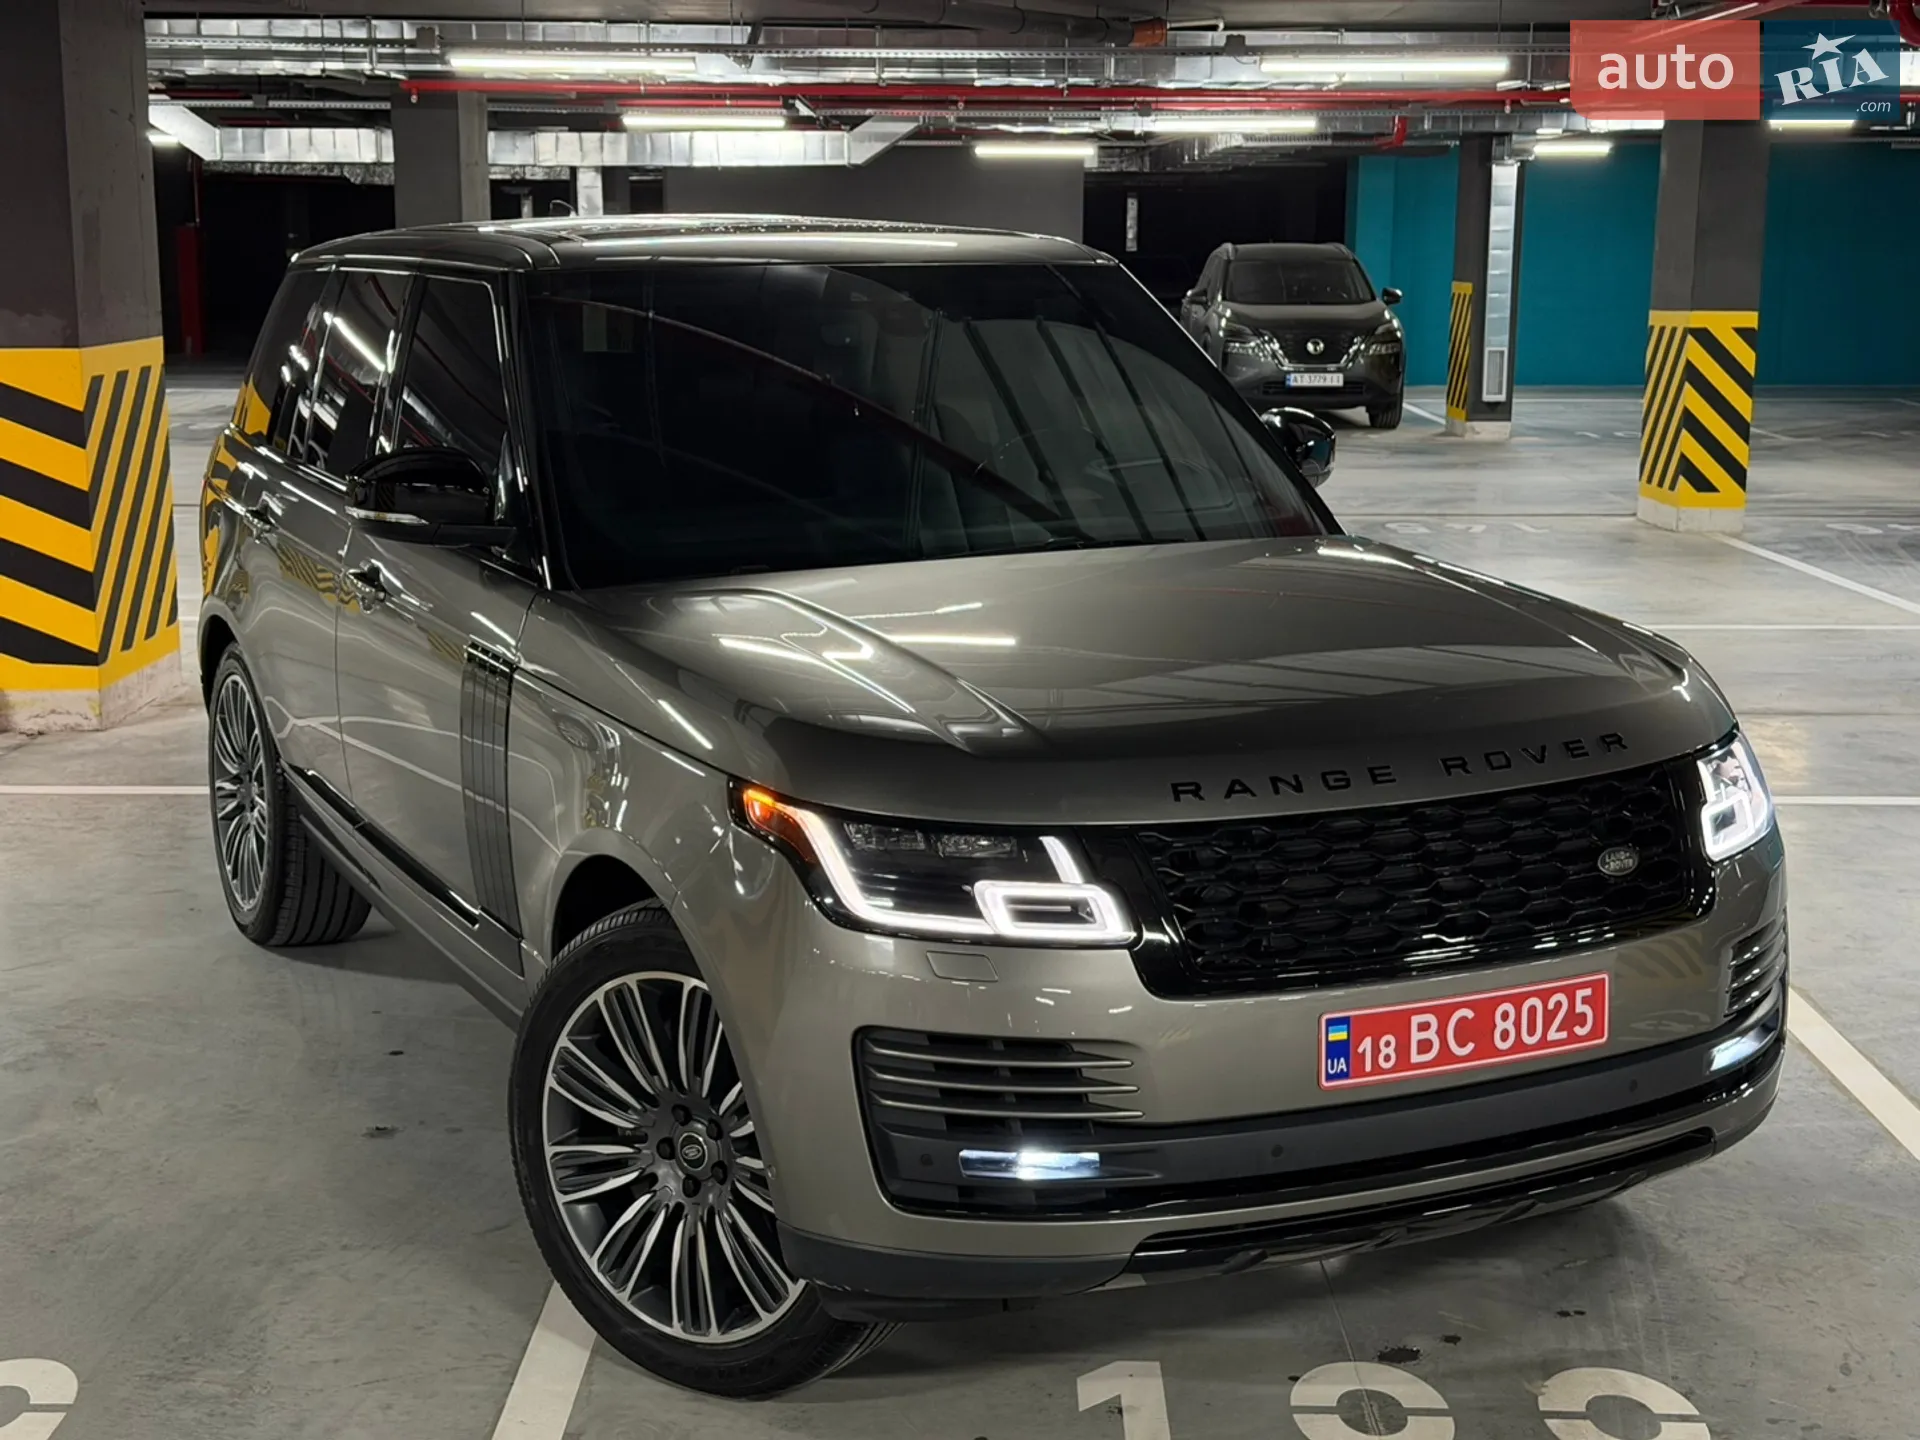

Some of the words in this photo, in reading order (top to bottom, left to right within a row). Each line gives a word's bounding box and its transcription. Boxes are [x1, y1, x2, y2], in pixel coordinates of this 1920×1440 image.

[1170, 765, 1397, 802] RANGE
[1439, 731, 1629, 777] ROVER
[1357, 1034, 1396, 1072] 18
[1410, 1008, 1475, 1064] BC
[1493, 987, 1594, 1050] 8025
[1327, 1058, 1347, 1075] UA
